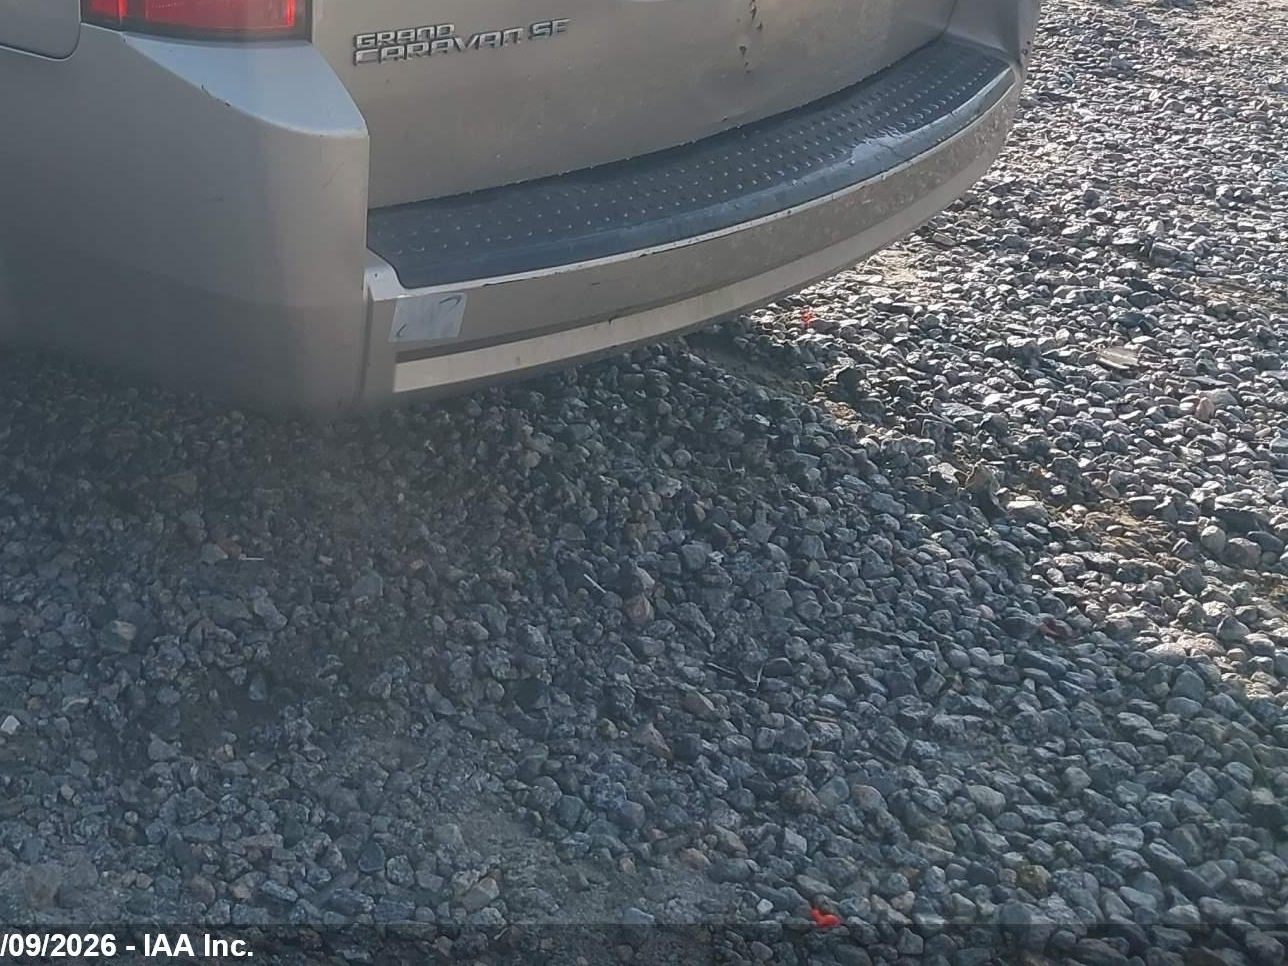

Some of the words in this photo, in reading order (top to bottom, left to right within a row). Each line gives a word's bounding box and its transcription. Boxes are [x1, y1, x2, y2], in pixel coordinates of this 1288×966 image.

[353, 27, 524, 66] CARAVAN
[528, 18, 571, 41] SE
[354, 23, 456, 50] GRAND
